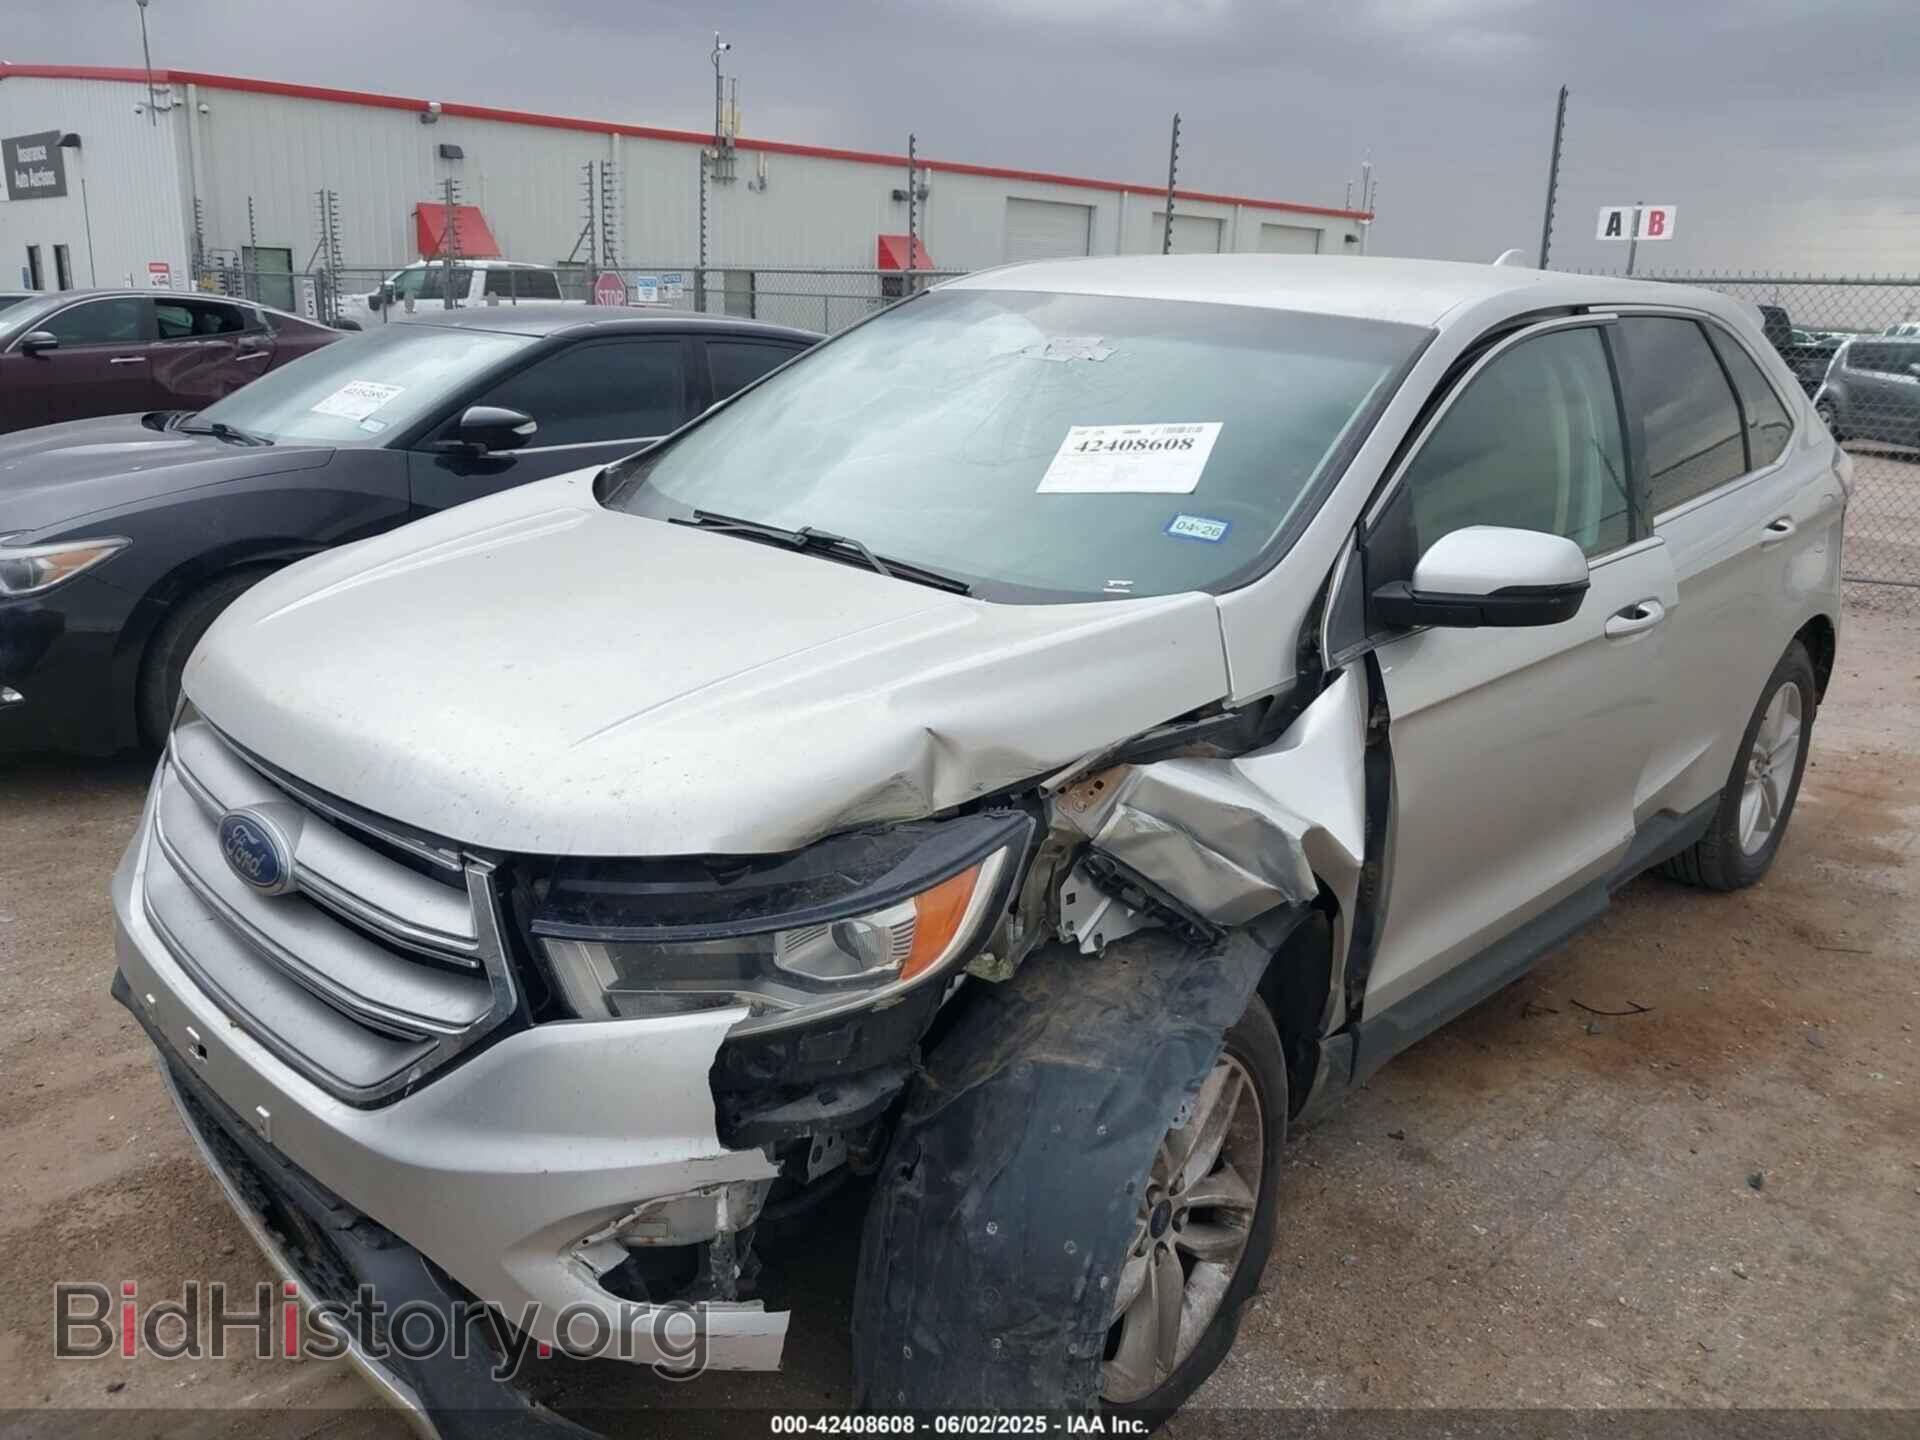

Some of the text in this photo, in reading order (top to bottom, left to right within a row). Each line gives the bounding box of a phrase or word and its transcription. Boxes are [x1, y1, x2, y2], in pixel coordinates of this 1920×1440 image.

[1605, 210, 1665, 236] A B
[599, 290, 625, 306] STOP
[1074, 438, 1195, 452] 42408608
